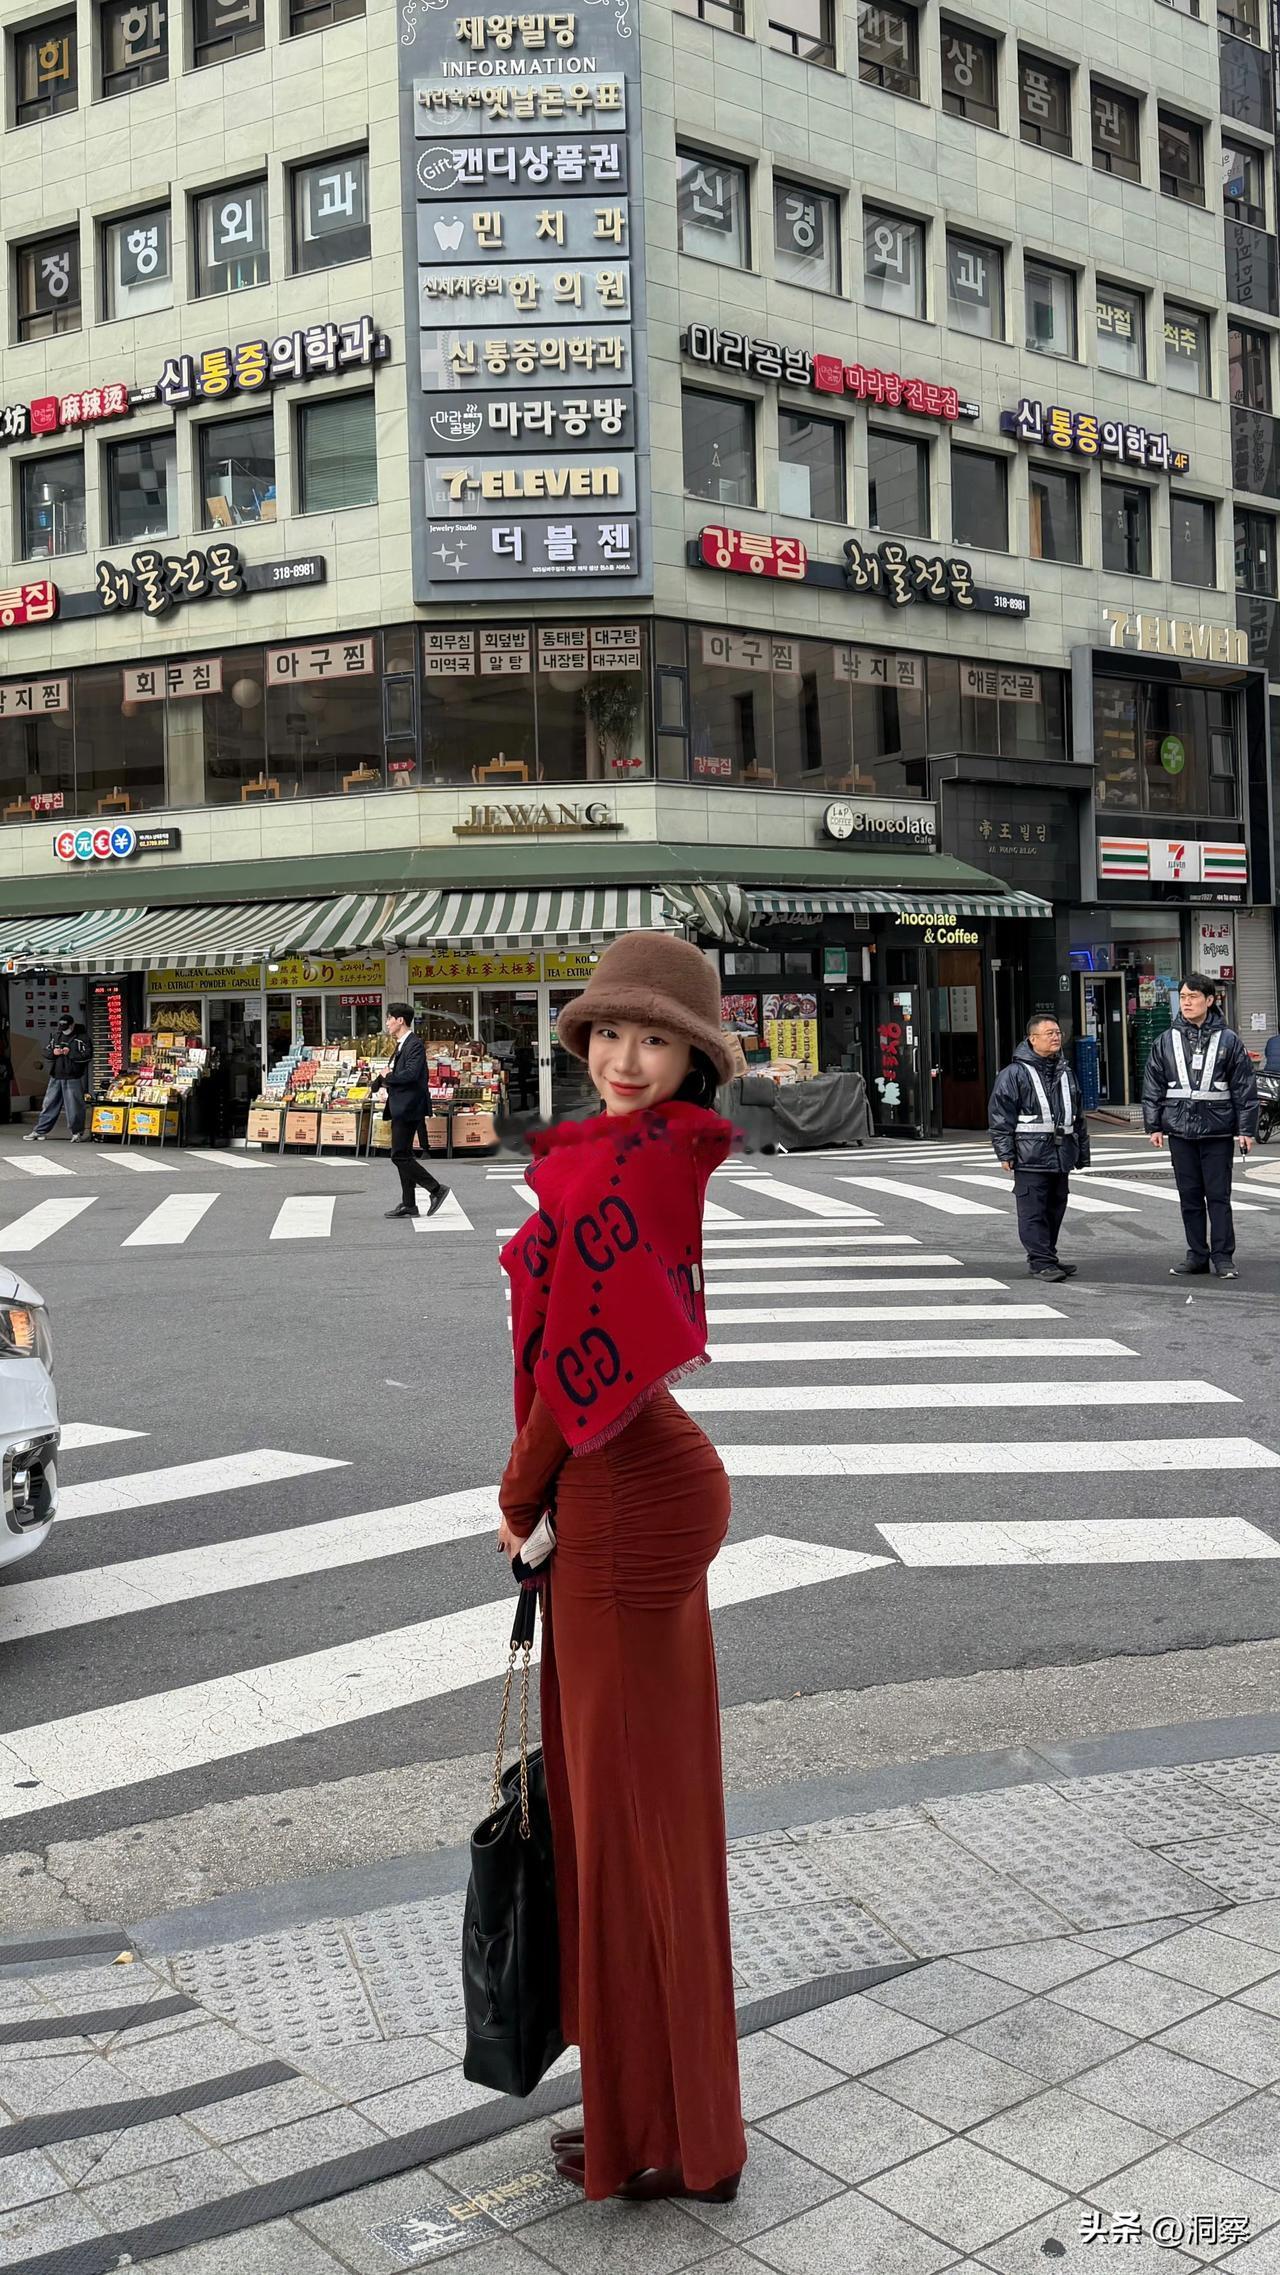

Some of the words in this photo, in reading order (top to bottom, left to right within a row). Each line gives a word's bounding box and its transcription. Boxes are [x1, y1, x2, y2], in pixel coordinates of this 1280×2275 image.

[121, 5, 165, 63] 한
[455, 14, 577, 50] 제왕빌딩
[442, 56, 597, 77] INFORMATION
[948, 38, 977, 86] 상
[482, 83, 623, 119] 옛날돈우표
[1024, 68, 1051, 118] 품
[423, 155, 454, 181] Gift
[452, 143, 620, 184] 캔디상품권
[41, 251, 69, 297] 정
[127, 227, 158, 274] 형
[220, 199, 252, 245] 외
[317, 171, 357, 217] 과
[689, 169, 724, 220] 신
[785, 195, 816, 248] 경
[874, 225, 903, 274] 외
[956, 251, 986, 296] 과
[1097, 303, 1131, 337] 관절
[450, 336, 625, 375] 신통증의학과
[690, 323, 813, 385] 마라공방
[1164, 324, 1196, 356] 척추
[160, 317, 374, 398] 신통증의학과
[61, 385, 123, 422] 麻辣烫
[850, 369, 901, 402] 마라탕
[908, 383, 957, 416] 전문점
[0, 405, 26, 436] 坊
[436, 411, 462, 423] 마라
[451, 422, 476, 435] 공방
[488, 399, 627, 437] 마라공방
[1018, 401, 1169, 470] 신통증의학과
[1174, 453, 1188, 469] 4F
[429, 524, 454, 532] Jewelry
[455, 524, 477, 532] Studio
[703, 527, 805, 580] 강릉집
[101, 548, 238, 611] 해물전문
[273, 563, 315, 581] 318-8981
[851, 544, 972, 604] 해물전문
[994, 595, 1026, 611] 318-8981
[430, 635, 471, 649] 회무침
[485, 633, 526, 648] 회덮밥
[542, 631, 585, 647] 동태탕
[595, 628, 638, 645] 대구탕
[430, 658, 471, 672] 미역국
[543, 654, 585, 669] 내장탕
[593, 653, 639, 667] 대구지리
[968, 669, 1034, 698] 해물전골
[464, 802, 611, 825] JEWANG
[853, 812, 935, 835] Chocolate
[914, 835, 932, 844] Cafe
[924, 929, 936, 944] &
[938, 928, 978, 944] Coffee
[152, 982, 162, 990] TEA
[168, 980, 194, 990] EXTRACT
[200, 980, 226, 988] POWDER
[232, 978, 260, 987] CAPSULE
[548, 969, 560, 977] TEA
